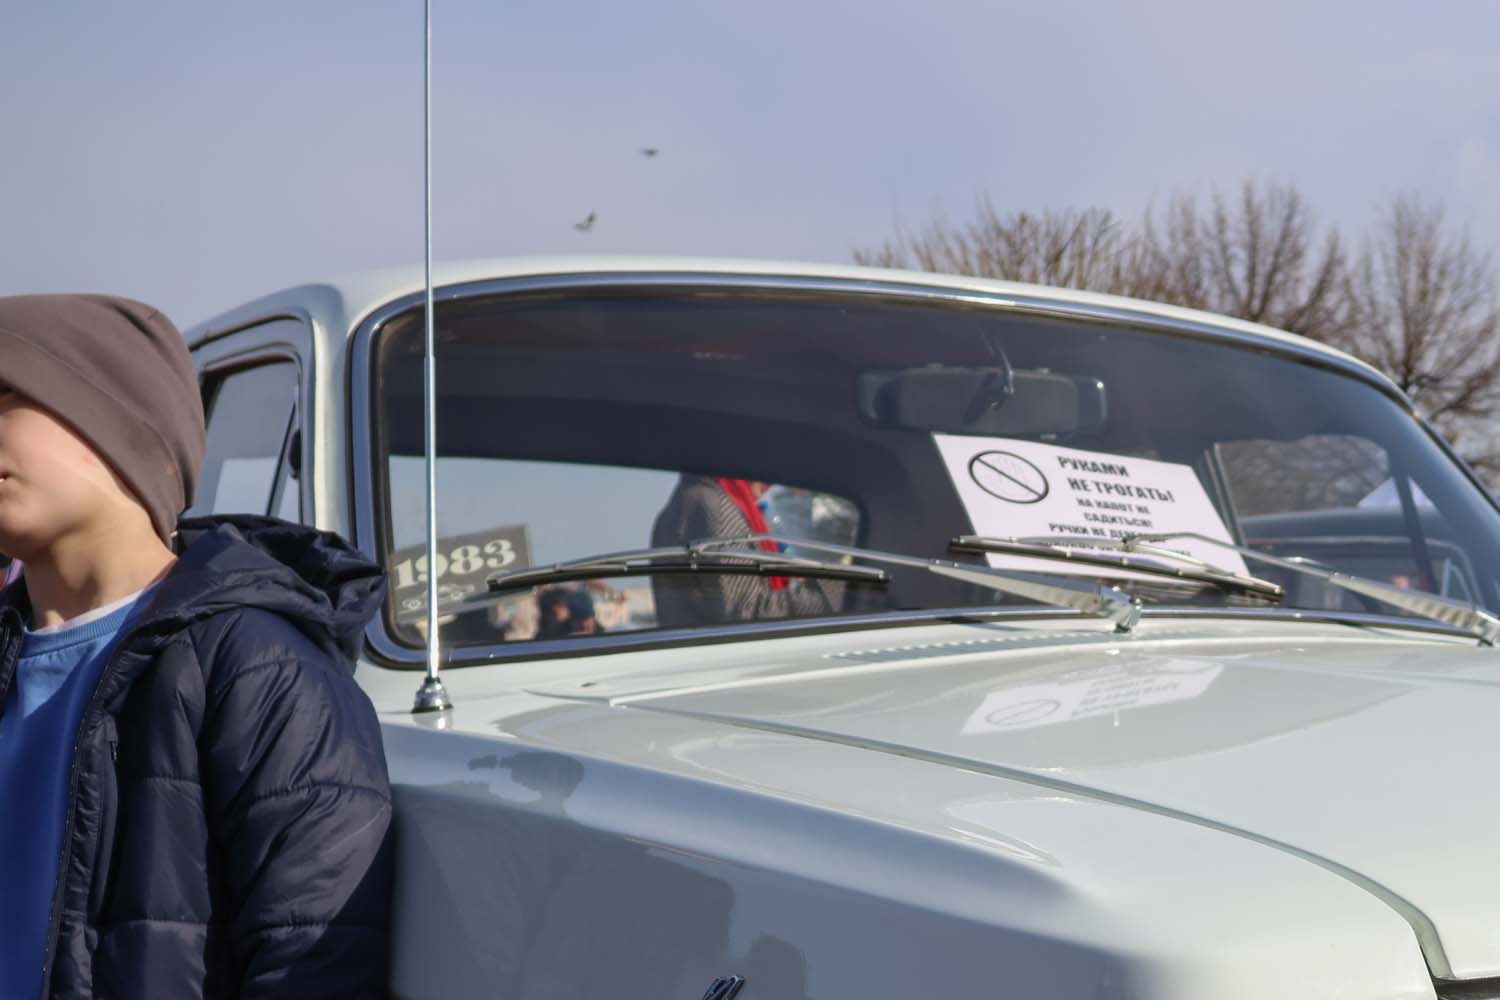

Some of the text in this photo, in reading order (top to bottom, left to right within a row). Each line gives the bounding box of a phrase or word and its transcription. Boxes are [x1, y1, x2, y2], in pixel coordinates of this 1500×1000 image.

[1057, 456, 1130, 477] РУКАМИ
[1067, 477, 1175, 503] НЕ ТРОГАТЬ!
[1076, 498, 1150, 515] НА КАПОТ НЕ
[1048, 523, 1088, 534] РУЧКИ
[1091, 527, 1106, 536] НЕ
[393, 539, 516, 589] 1983
